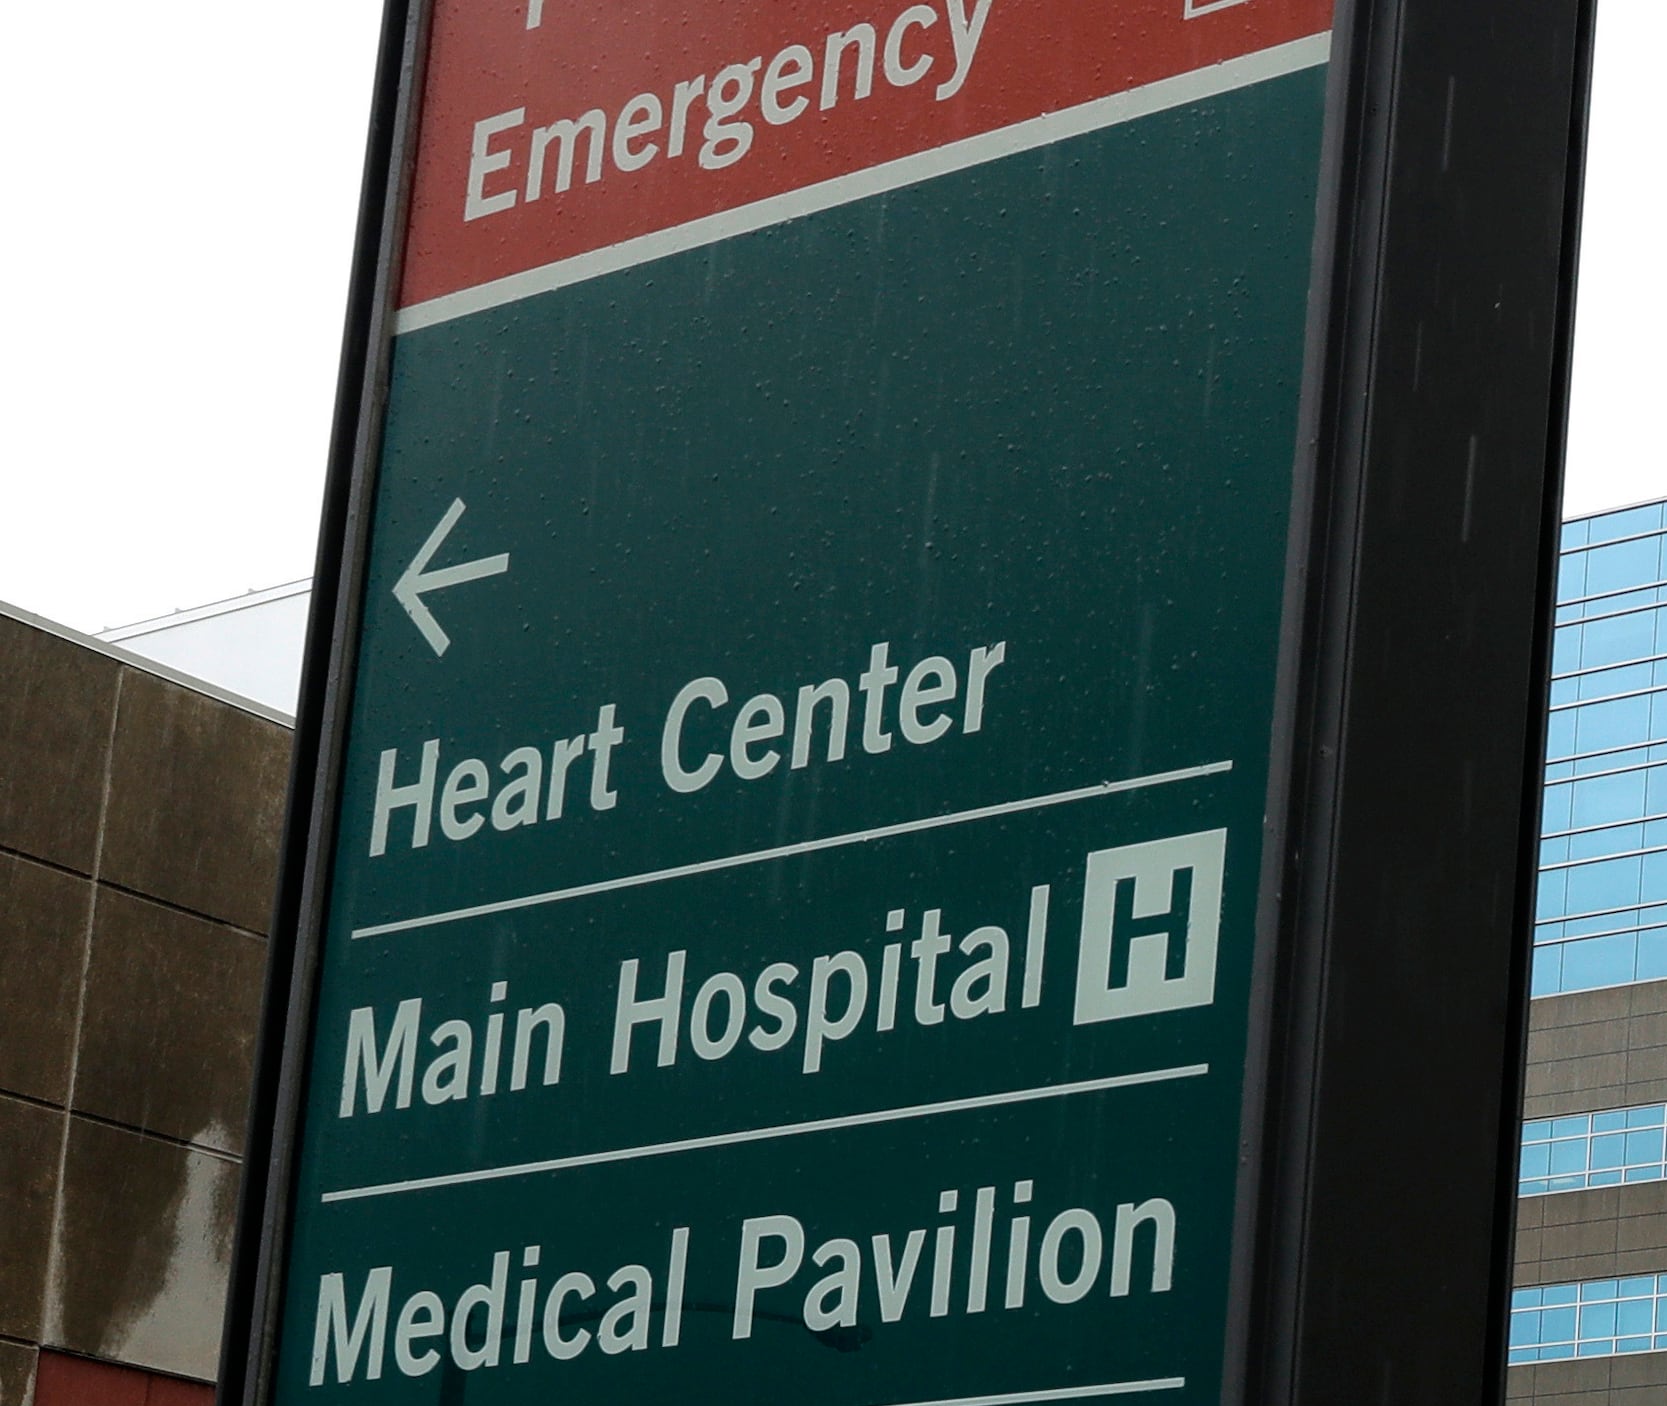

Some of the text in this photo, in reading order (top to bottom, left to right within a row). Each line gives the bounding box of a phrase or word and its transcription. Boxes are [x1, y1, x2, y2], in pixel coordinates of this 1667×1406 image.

[463, 0, 995, 222] Emergency
[369, 641, 1006, 857] Heart Center
[339, 867, 1194, 1118] Main Hospital H
[309, 1179, 1176, 1386] Medical Pavilion
